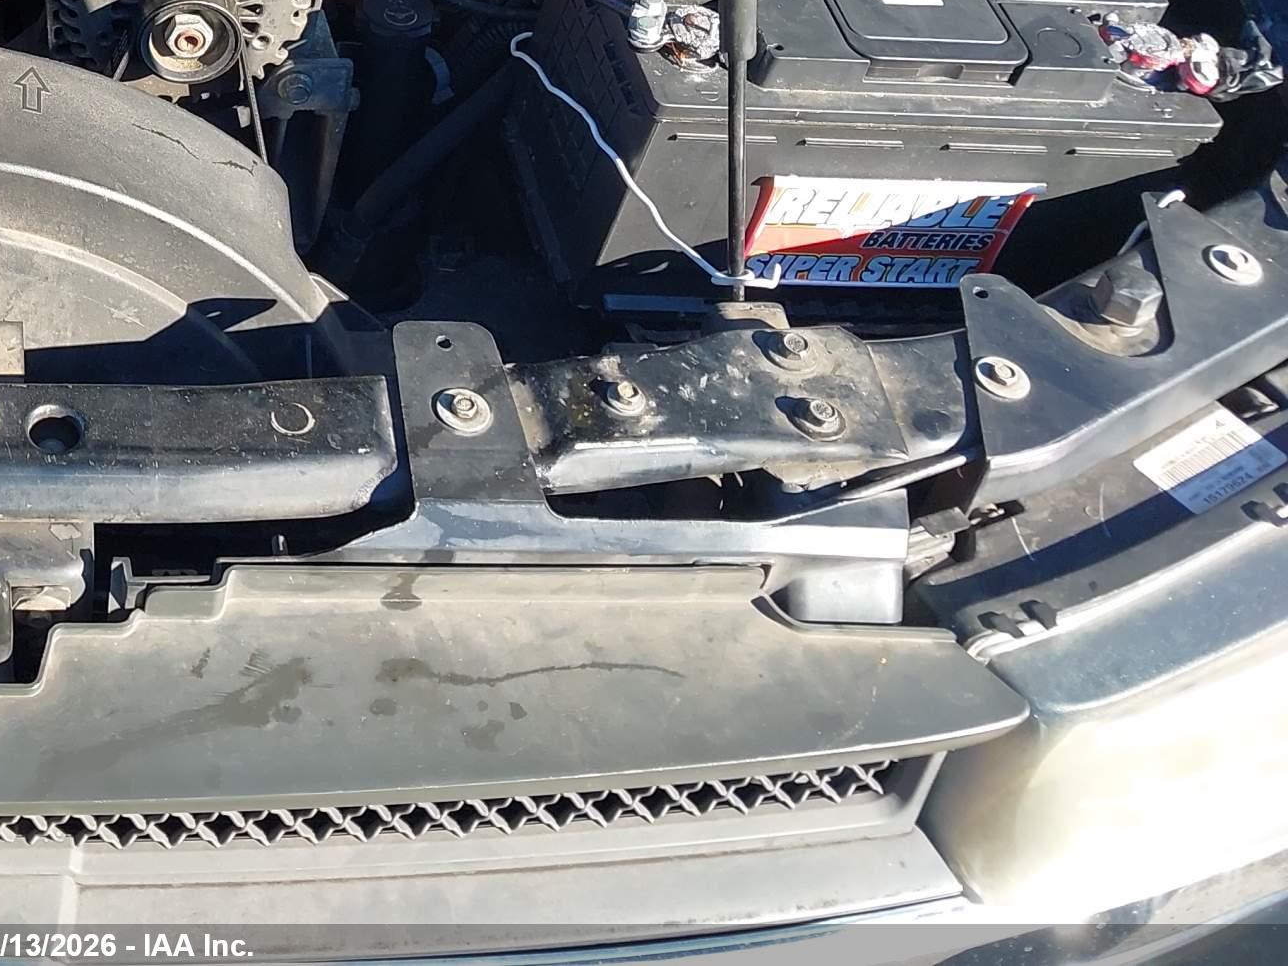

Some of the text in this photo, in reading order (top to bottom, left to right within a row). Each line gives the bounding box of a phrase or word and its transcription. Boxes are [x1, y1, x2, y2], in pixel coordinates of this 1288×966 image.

[764, 188, 1011, 229] RELIABLE
[861, 231, 996, 252] BATTERIES
[745, 254, 862, 283] SUPER
[862, 255, 982, 284] START
